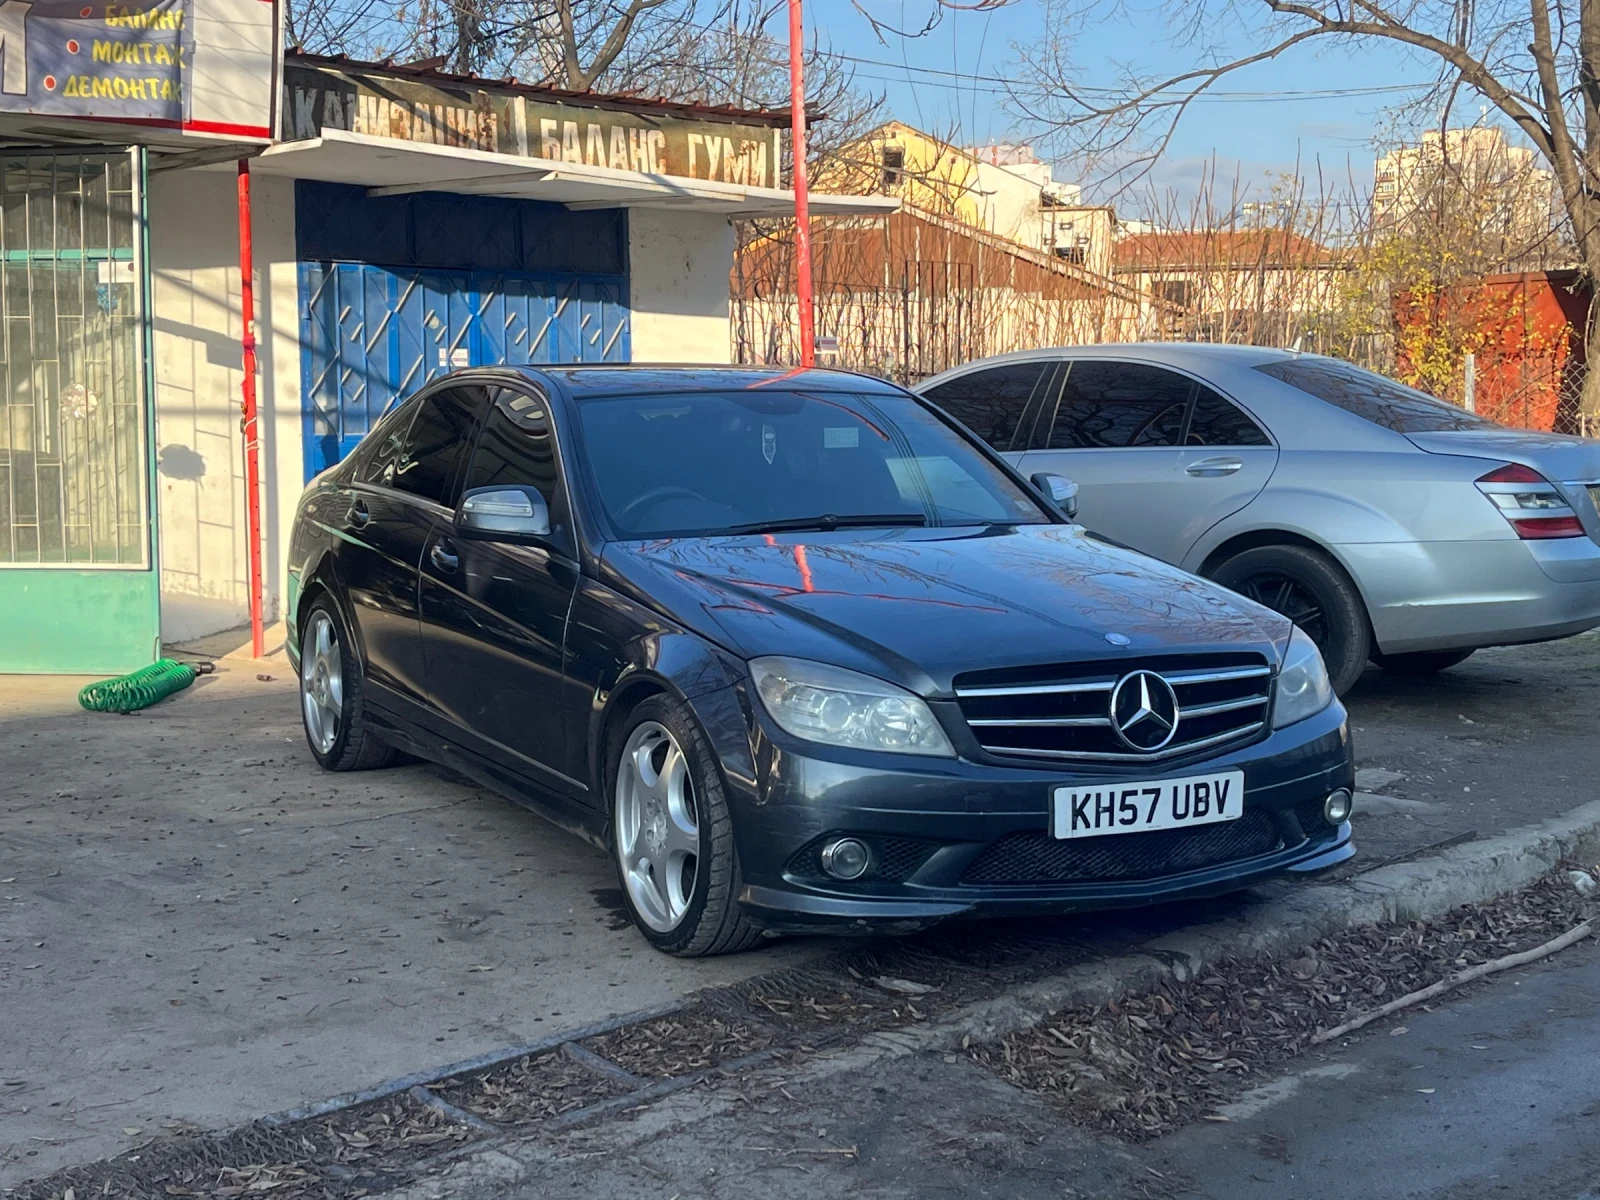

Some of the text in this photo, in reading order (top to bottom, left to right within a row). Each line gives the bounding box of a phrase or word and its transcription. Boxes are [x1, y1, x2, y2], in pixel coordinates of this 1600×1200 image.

[104, 5, 186, 31] БАЛАНС
[539, 118, 767, 188] БАЛАНС ГУМИ
[1071, 779, 1231, 831] KH57 UBV
